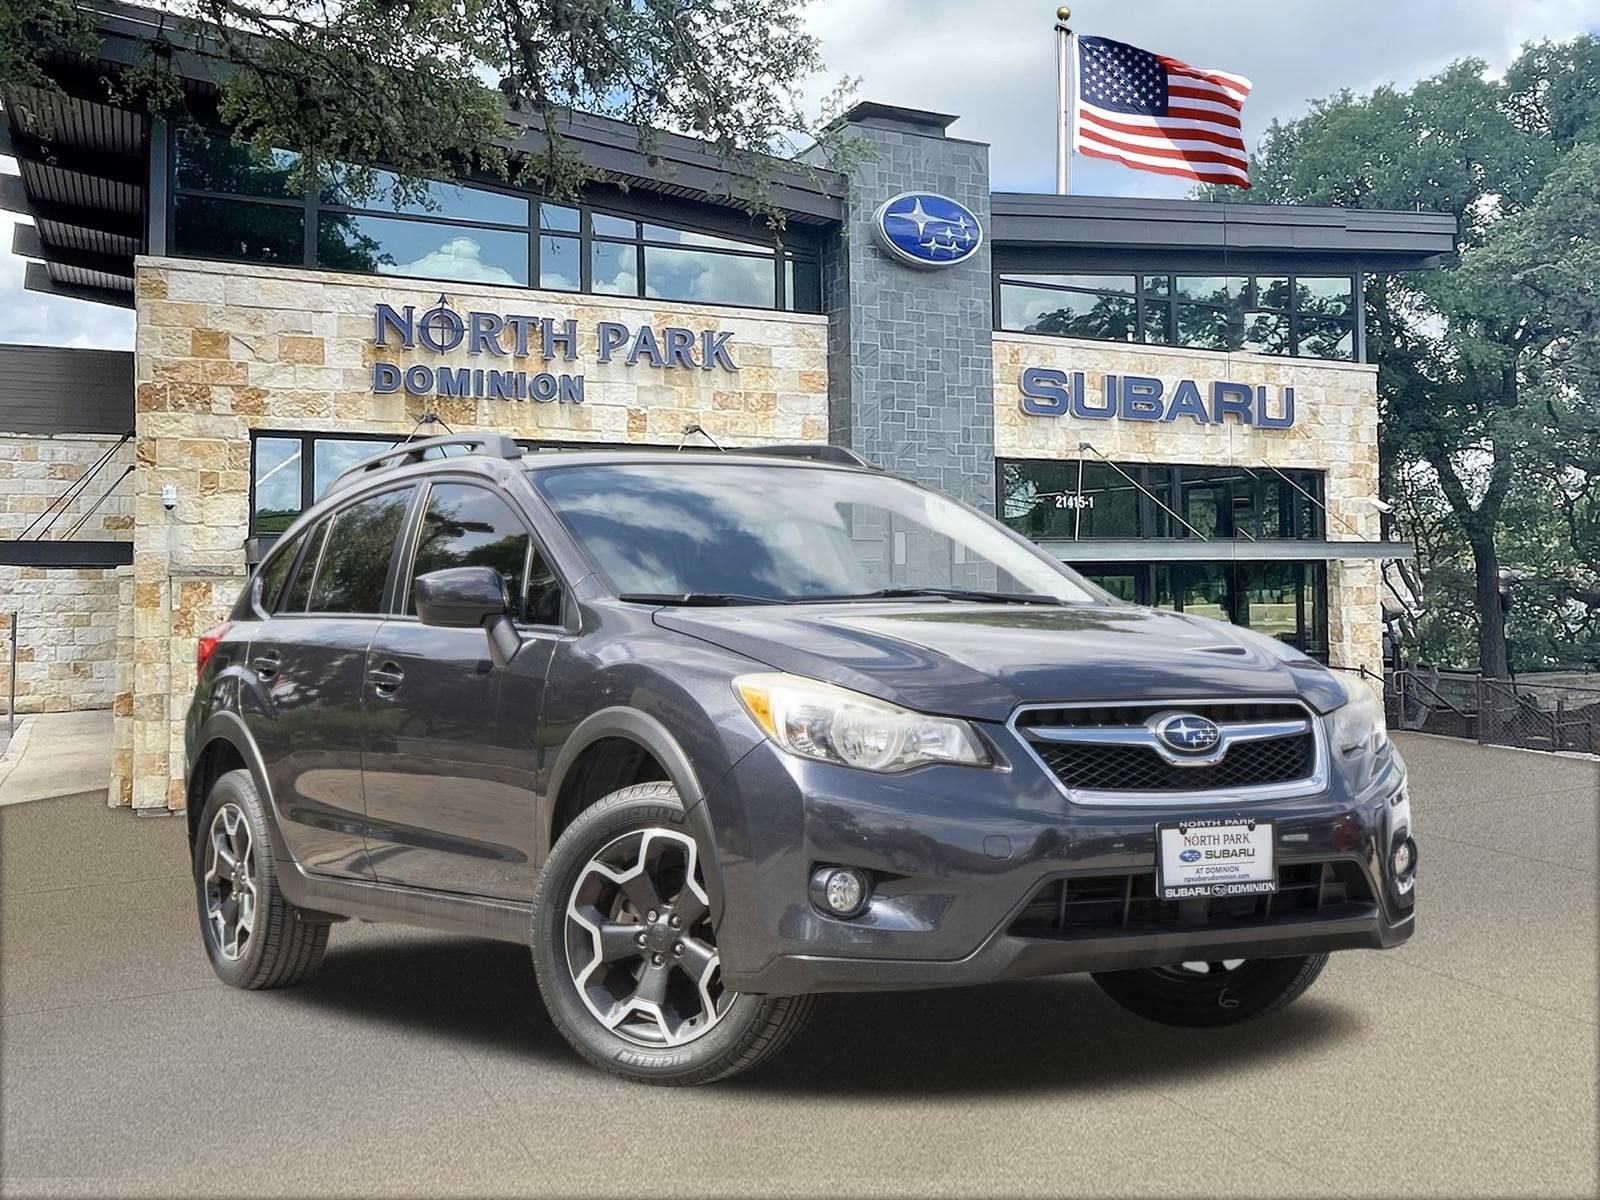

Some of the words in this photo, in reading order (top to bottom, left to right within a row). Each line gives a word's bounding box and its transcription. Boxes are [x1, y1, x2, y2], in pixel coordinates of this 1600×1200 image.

[374, 293, 579, 361] NORTH
[597, 321, 741, 372] PARK
[373, 362, 585, 403] DOMINION
[1019, 367, 1294, 429] SUBARU
[1055, 495, 1094, 509] 21415-1
[1179, 820, 1221, 828] NORTH
[1184, 834, 1220, 846] NORTH
[1223, 833, 1250, 845] PARK
[1204, 848, 1256, 859] SUBARU
[1205, 865, 1240, 874] DOMINION
[1165, 887, 1211, 898] SUBARU
[1228, 882, 1276, 894] DOMINION
[616, 1051, 692, 1067] MICHELIN
